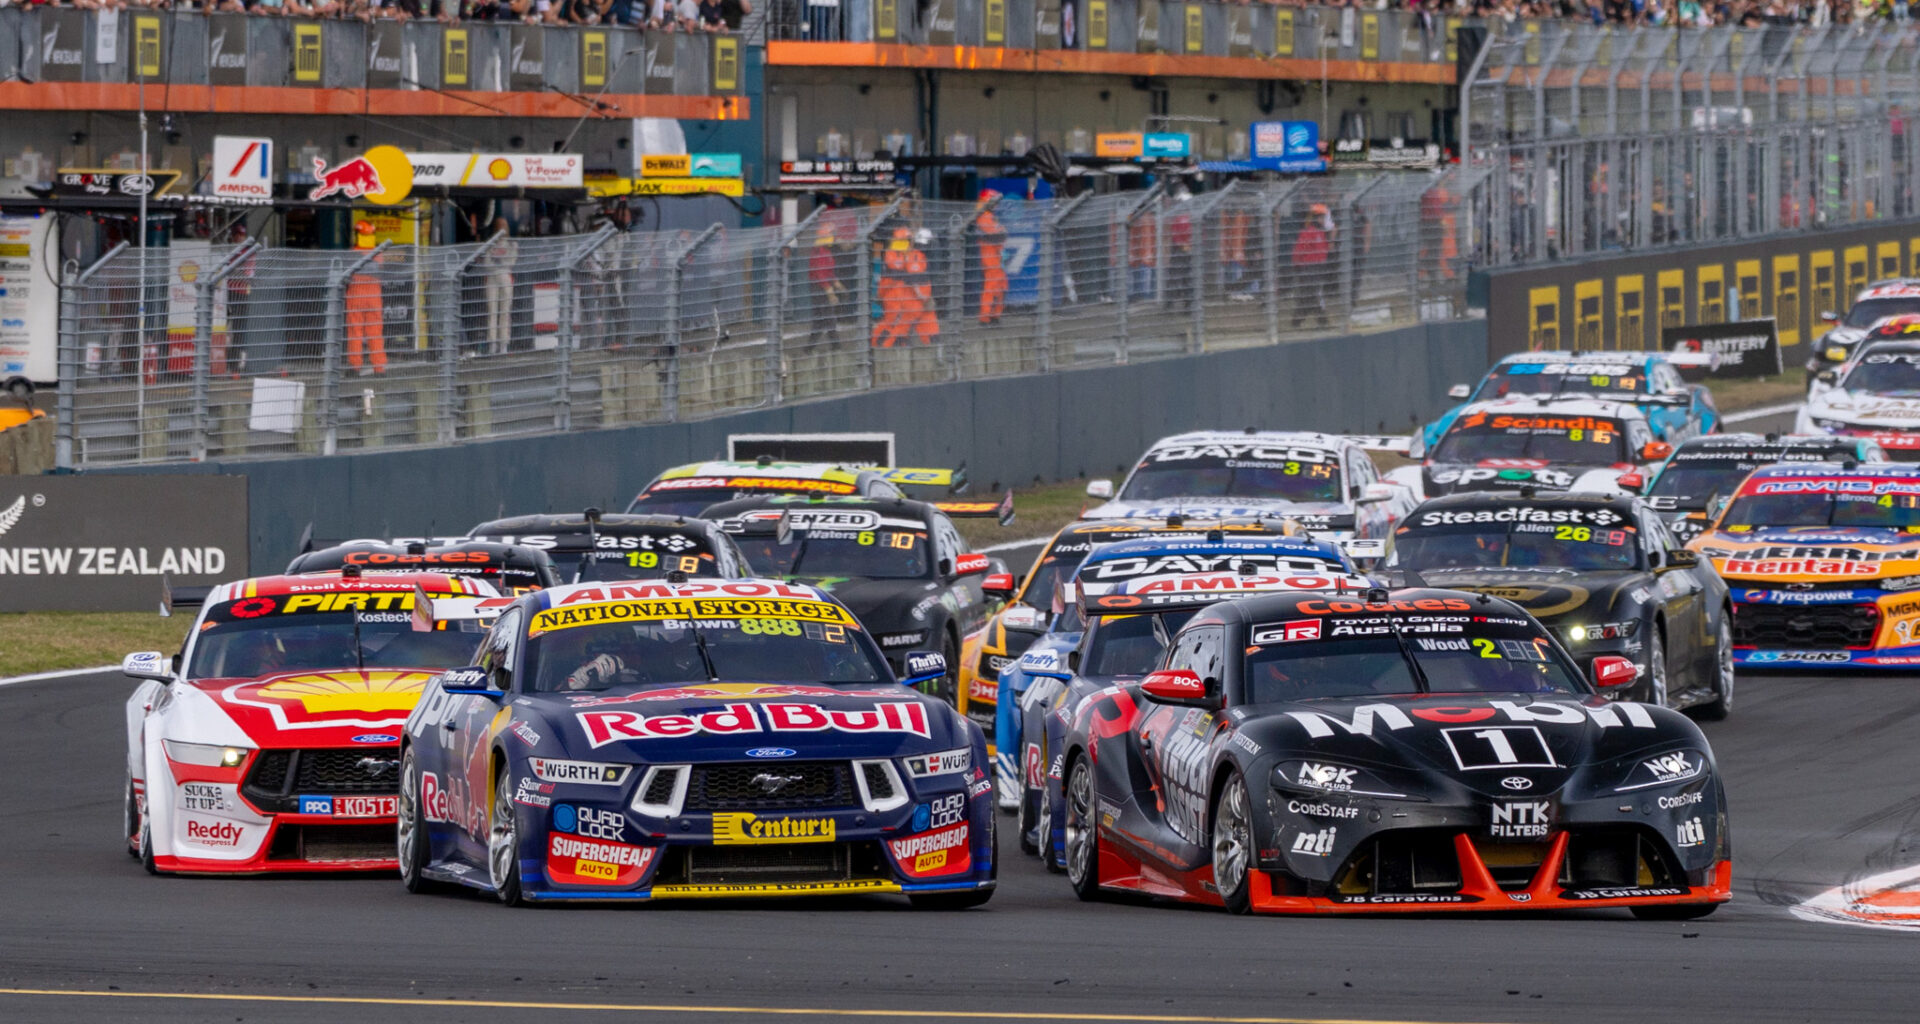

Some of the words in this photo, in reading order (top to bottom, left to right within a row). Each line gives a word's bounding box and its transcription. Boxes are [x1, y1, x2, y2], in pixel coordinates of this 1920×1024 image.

[217, 183, 268, 195] AMPOL
[1702, 335, 1769, 353] BATTERY
[1589, 375, 1610, 387] 10
[1491, 415, 1615, 431] Scandia
[1569, 428, 1584, 442] 8
[1155, 445, 1331, 463] DAYCO
[1676, 452, 1749, 461] Industrial
[1226, 458, 1284, 470] Cameron
[1283, 461, 1301, 476] 3
[651, 477, 728, 492] MEGA
[727, 477, 857, 494] REWARDS
[1877, 494, 1894, 508] 4
[788, 513, 866, 525] ENZED
[1421, 507, 1583, 526] Steadfast
[806, 530, 857, 540] Waters
[857, 531, 876, 546] 6
[890, 532, 914, 550] 10
[1515, 524, 1555, 534] Allen
[1554, 525, 1592, 542] 26
[1166, 540, 1278, 550] Etheridge
[1281, 541, 1320, 552] Ford
[1, 547, 71, 575] NEW
[78, 547, 226, 575] ZEALAND
[627, 552, 658, 568] 19
[679, 556, 699, 574] 8
[957, 559, 990, 571] RYCO
[1098, 554, 1328, 579] DAYCO
[1723, 559, 1881, 576] Rentals
[484, 568, 536, 577] Racing
[290, 583, 334, 592] Shell
[560, 582, 814, 605] AMPOL
[1132, 575, 1369, 595] AMPOL
[1770, 589, 1854, 605] Tyrepower
[539, 601, 691, 629] NATIONAL
[701, 599, 839, 621] STORAGE
[1296, 597, 1472, 616] Coates
[356, 611, 413, 623] Kosteck
[1331, 615, 1404, 626] TOYOTA
[1408, 616, 1471, 624] GAZOO
[1473, 616, 1528, 626] Racing
[662, 618, 737, 631] Brown
[739, 618, 803, 636] 888
[1253, 620, 1321, 645] GR
[1330, 622, 1464, 637] Australia
[1416, 638, 1470, 652] Wood
[1472, 638, 1503, 659] 2
[909, 653, 946, 670] Thrifty
[1021, 653, 1058, 668] Thrifty
[1173, 676, 1200, 688] BOC
[576, 703, 764, 749] Red
[760, 702, 931, 740] Bull
[1474, 729, 1519, 764] 1
[1298, 761, 1358, 784] NGK
[1643, 751, 1693, 777] NGK
[184, 784, 215, 798] SUCK
[513, 788, 552, 808] Partners
[185, 796, 198, 809] IT
[199, 797, 216, 810] UP
[304, 801, 330, 813] PPQ
[931, 793, 965, 814] QUAD
[577, 806, 625, 828] QUAD
[930, 808, 964, 829] LOCK
[1492, 800, 1550, 825] NTK
[187, 820, 244, 847] Reddy
[577, 820, 626, 842] LOCK
[1491, 824, 1549, 838] FILTERS
[1676, 816, 1706, 844] nti
[201, 839, 233, 847] express
[893, 825, 969, 860] SUPERCHEAP
[1292, 826, 1337, 854] nti
[551, 836, 652, 868] SUPERCHEAP
[580, 862, 614, 877] AUTO
[918, 855, 944, 869] AUTO
[1343, 895, 1367, 904] JB
[1370, 895, 1463, 904] Caravans
[1598, 886, 1682, 899] Caravans
